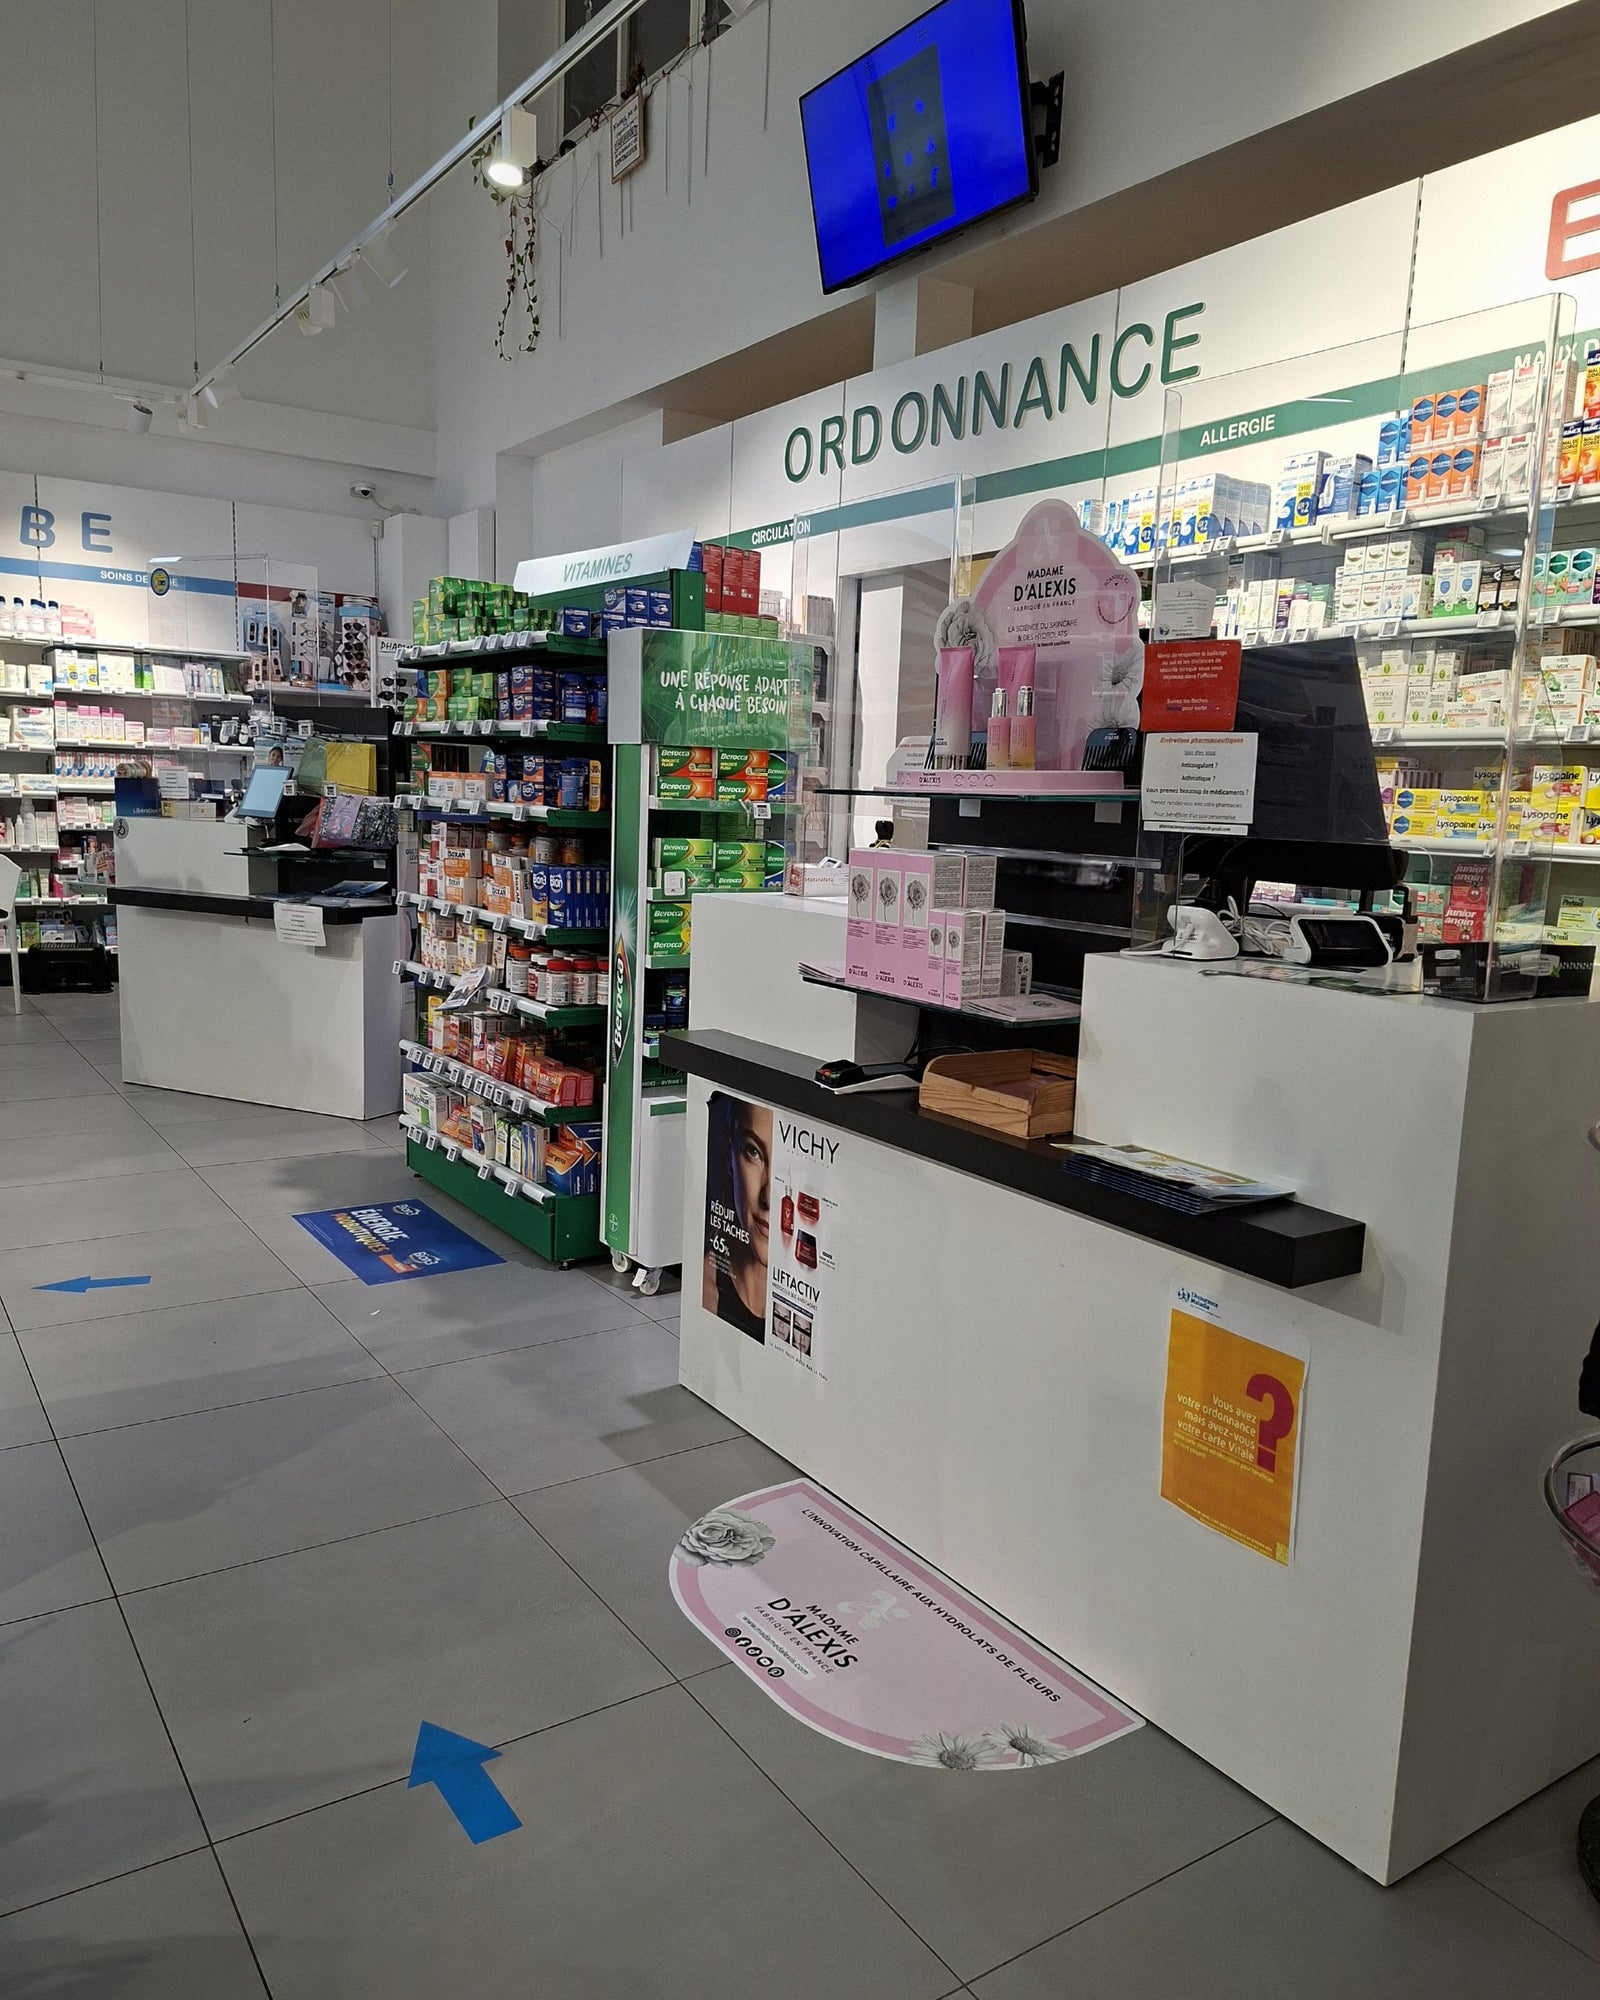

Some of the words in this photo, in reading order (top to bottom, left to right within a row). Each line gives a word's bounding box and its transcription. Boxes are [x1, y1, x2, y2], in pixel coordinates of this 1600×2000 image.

[783, 301, 1206, 484] ORDONNANCE
[1200, 413, 1276, 447] ALLERGIE
[100, 570, 133, 582] SOINS
[135, 573, 149, 584] DE
[563, 553, 633, 583] VITAMINES
[1027, 565, 1064, 580] MADAME
[1013, 578, 1076, 602] D'ALEXIS
[1052, 599, 1076, 607] FRANCE
[1016, 623, 1039, 632] SCIENCE
[1040, 622, 1049, 630] DU
[1050, 619, 1078, 629] SKINCARE
[1023, 633, 1034, 641] DES
[1034, 630, 1068, 640] HYDROLATS
[660, 669, 689, 688] UNE
[693, 669, 750, 693] RÉPONSE
[675, 689, 685, 711] À
[690, 693, 742, 713] CHAQUE
[1190, 737, 1244, 745] pharmaceutiques
[661, 749, 690, 758] Berocca
[720, 752, 748, 761] Berocca
[660, 783, 691, 791] Berocca
[718, 786, 747, 794] Berocca
[663, 844, 689, 852] Berocca
[718, 848, 743, 856] Berocca
[1453, 872, 1485, 883] angin
[1455, 863, 1488, 874] junior
[719, 877, 743, 885] Berocca
[653, 910, 684, 918] Berocca
[1443, 916, 1475, 927] angin
[1444, 907, 1477, 918] junior
[653, 941, 682, 949] Berocca
[613, 957, 625, 1049] Berocca
[778, 1120, 840, 1164] VICHY
[711, 1200, 736, 1222] RÉDUIT
[351, 1208, 409, 1244] ÉNERGIE
[710, 1214, 721, 1230] LES
[722, 1220, 750, 1245] TACHES
[709, 1235, 731, 1257] -65%
[772, 1265, 821, 1303] LIFTACTIV
[1177, 1393, 1201, 1411] votre
[1202, 1405, 1256, 1437] ordonnance
[1212, 1394, 1234, 1413] Vous
[1235, 1407, 1257, 1424] avez
[1177, 1420, 1201, 1437] votre
[1202, 1431, 1226, 1449] carte
[1228, 1440, 1254, 1462] Vitale
[1184, 1410, 1206, 1426] mais
[1207, 1420, 1255, 1450] avez-vous
[801, 1508, 862, 1552] L'INNOVATION
[859, 1551, 915, 1592] CAPILLAIRE
[911, 1591, 937, 1609] AUX
[932, 1606, 998, 1656] HYDROLATS
[996, 1653, 1014, 1669] DE
[1012, 1667, 1061, 1703] FLEURS
[767, 1597, 858, 1668] D'ALEXIS
[806, 1604, 859, 1645] MADAME
[742, 1615, 809, 1676] www.madamedalexis.com
[789, 1636, 802, 1647] EN
[801, 1647, 834, 1675] FRANCE
